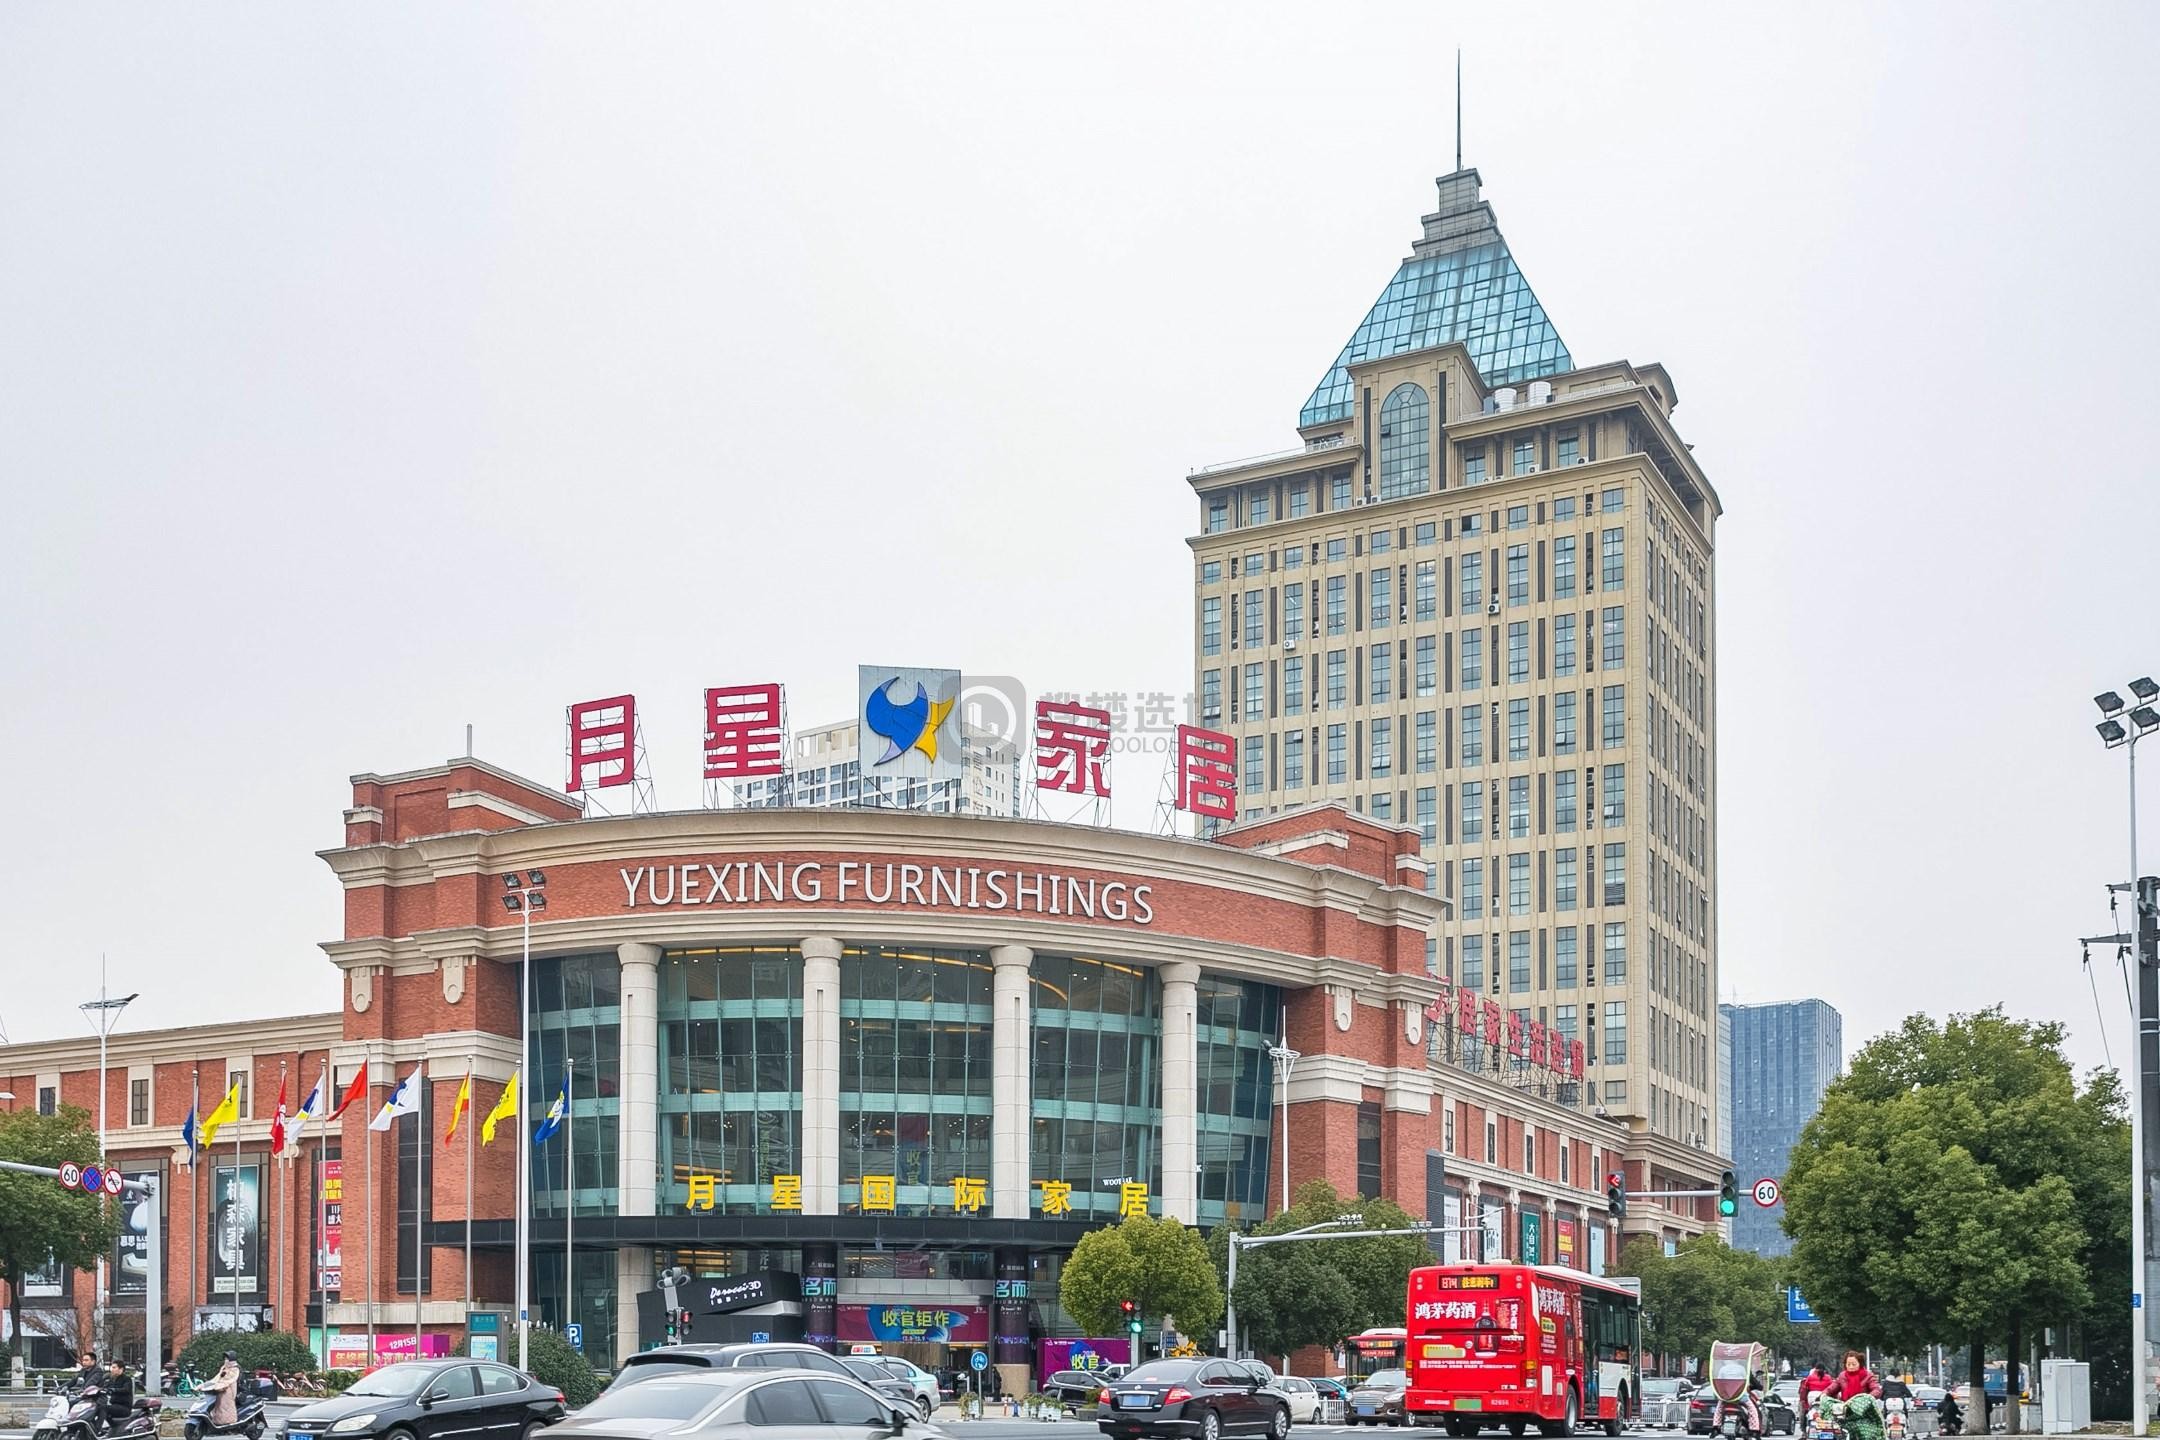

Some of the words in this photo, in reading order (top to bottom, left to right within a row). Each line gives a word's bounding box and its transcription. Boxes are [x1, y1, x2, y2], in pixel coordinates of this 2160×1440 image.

[619, 859, 822, 907] YUEXING
[836, 862, 1154, 924] FURNISHINGS
[63, 1169, 78, 1182] 60
[686, 1174, 1148, 1217] 月星国际家居
[1757, 1187, 1776, 1201] 60
[882, 1310, 950, 1327] 收官钜作
[1415, 1301, 1476, 1319] 鸿茅药酒
[569, 1327, 578, 1343] P
